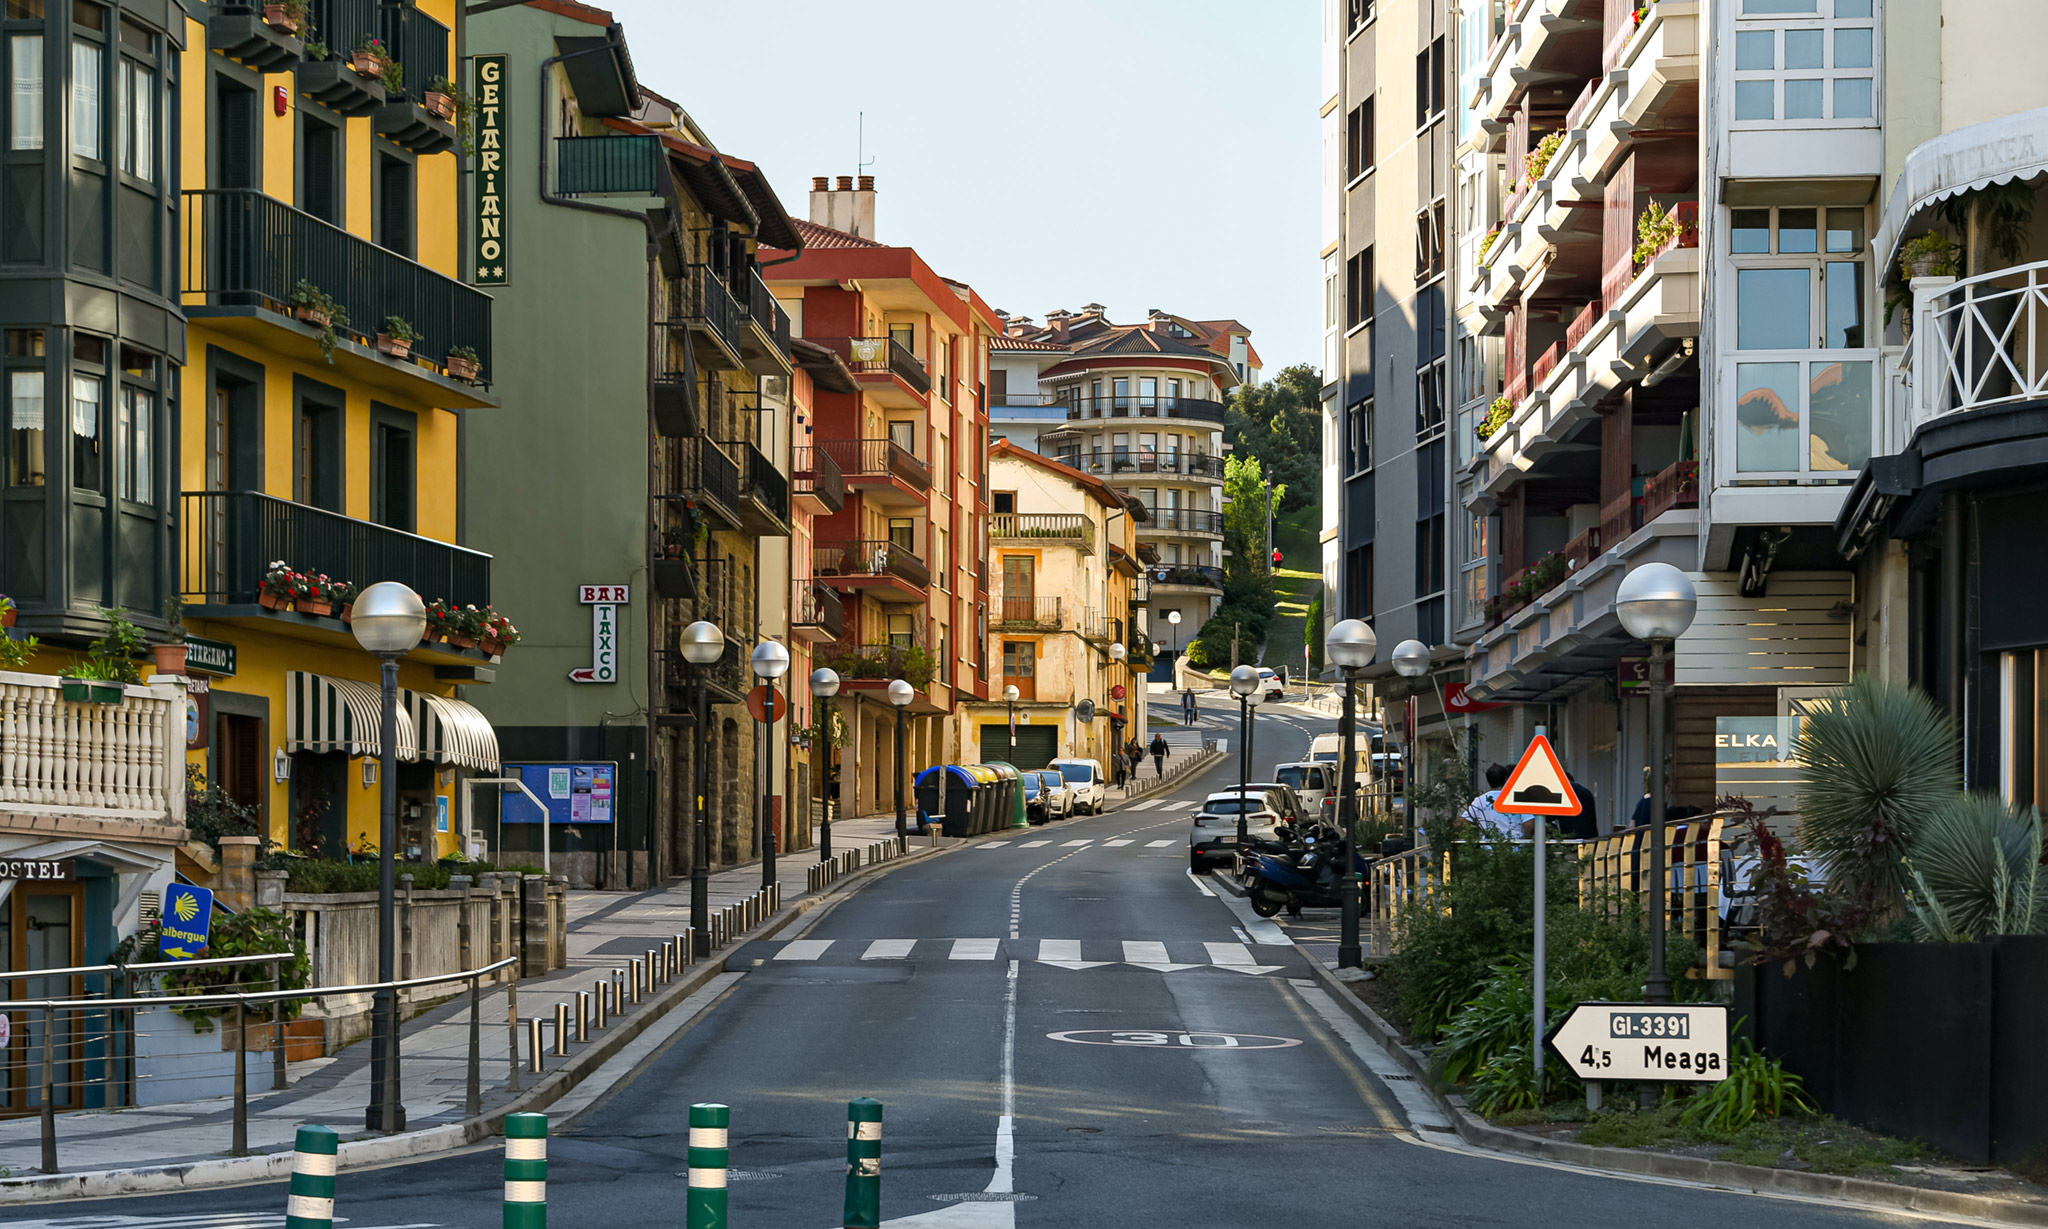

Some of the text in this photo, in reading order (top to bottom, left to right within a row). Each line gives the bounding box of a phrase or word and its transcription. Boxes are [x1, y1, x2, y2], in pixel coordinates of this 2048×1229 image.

[583, 587, 626, 601] BAR
[598, 606, 612, 680] TAXCO
[440, 804, 446, 823] P
[162, 926, 206, 943] albergue
[1612, 1016, 1688, 1036] GI-3391
[1112, 1032, 1239, 1047] 30
[1580, 1045, 1721, 1075] 4,5 Meaga
